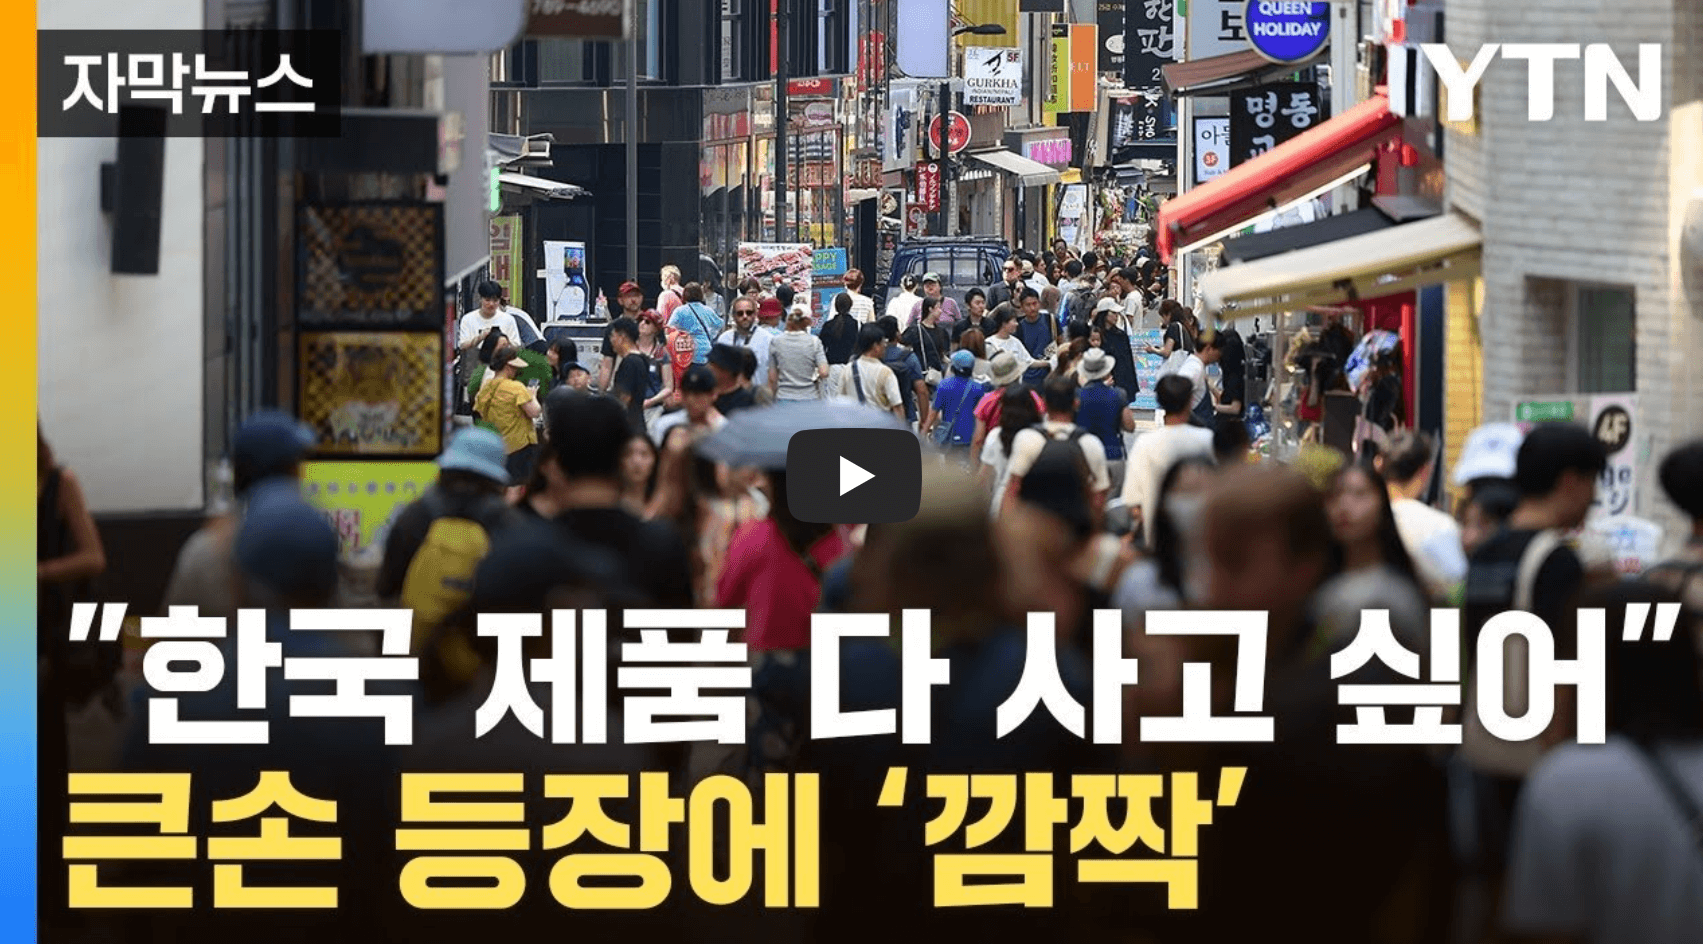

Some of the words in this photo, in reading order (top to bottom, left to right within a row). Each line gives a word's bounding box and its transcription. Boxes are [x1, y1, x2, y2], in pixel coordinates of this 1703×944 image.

[1259, 1, 1312, 15] QUEEN
[1253, 22, 1322, 36] HOLIDAY
[967, 77, 1019, 88] GURKHA
[969, 95, 1016, 104] RESTAURANT
[1246, 91, 1318, 128] 명동
